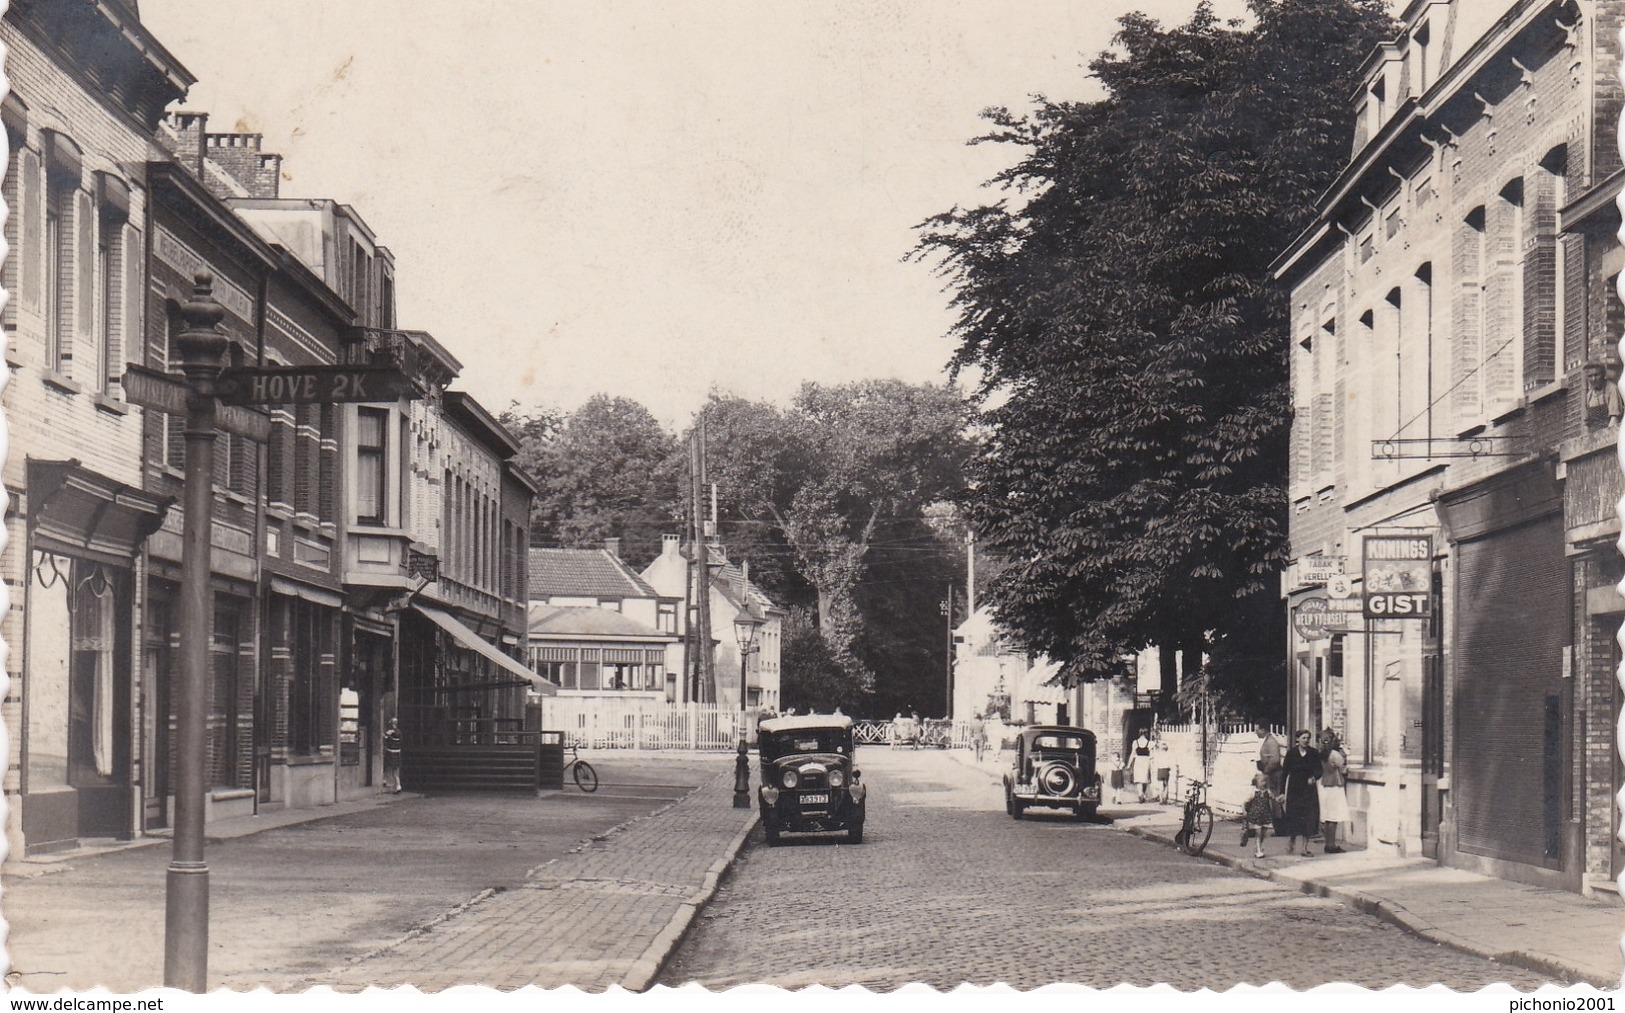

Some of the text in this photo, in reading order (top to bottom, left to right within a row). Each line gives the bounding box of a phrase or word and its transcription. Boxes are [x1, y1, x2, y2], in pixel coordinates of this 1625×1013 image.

[252, 374, 367, 400] HOVE 2K
[1368, 540, 1428, 559] KONINGS
[1308, 560, 1333, 568] TABAK
[1369, 595, 1428, 614] GIST
